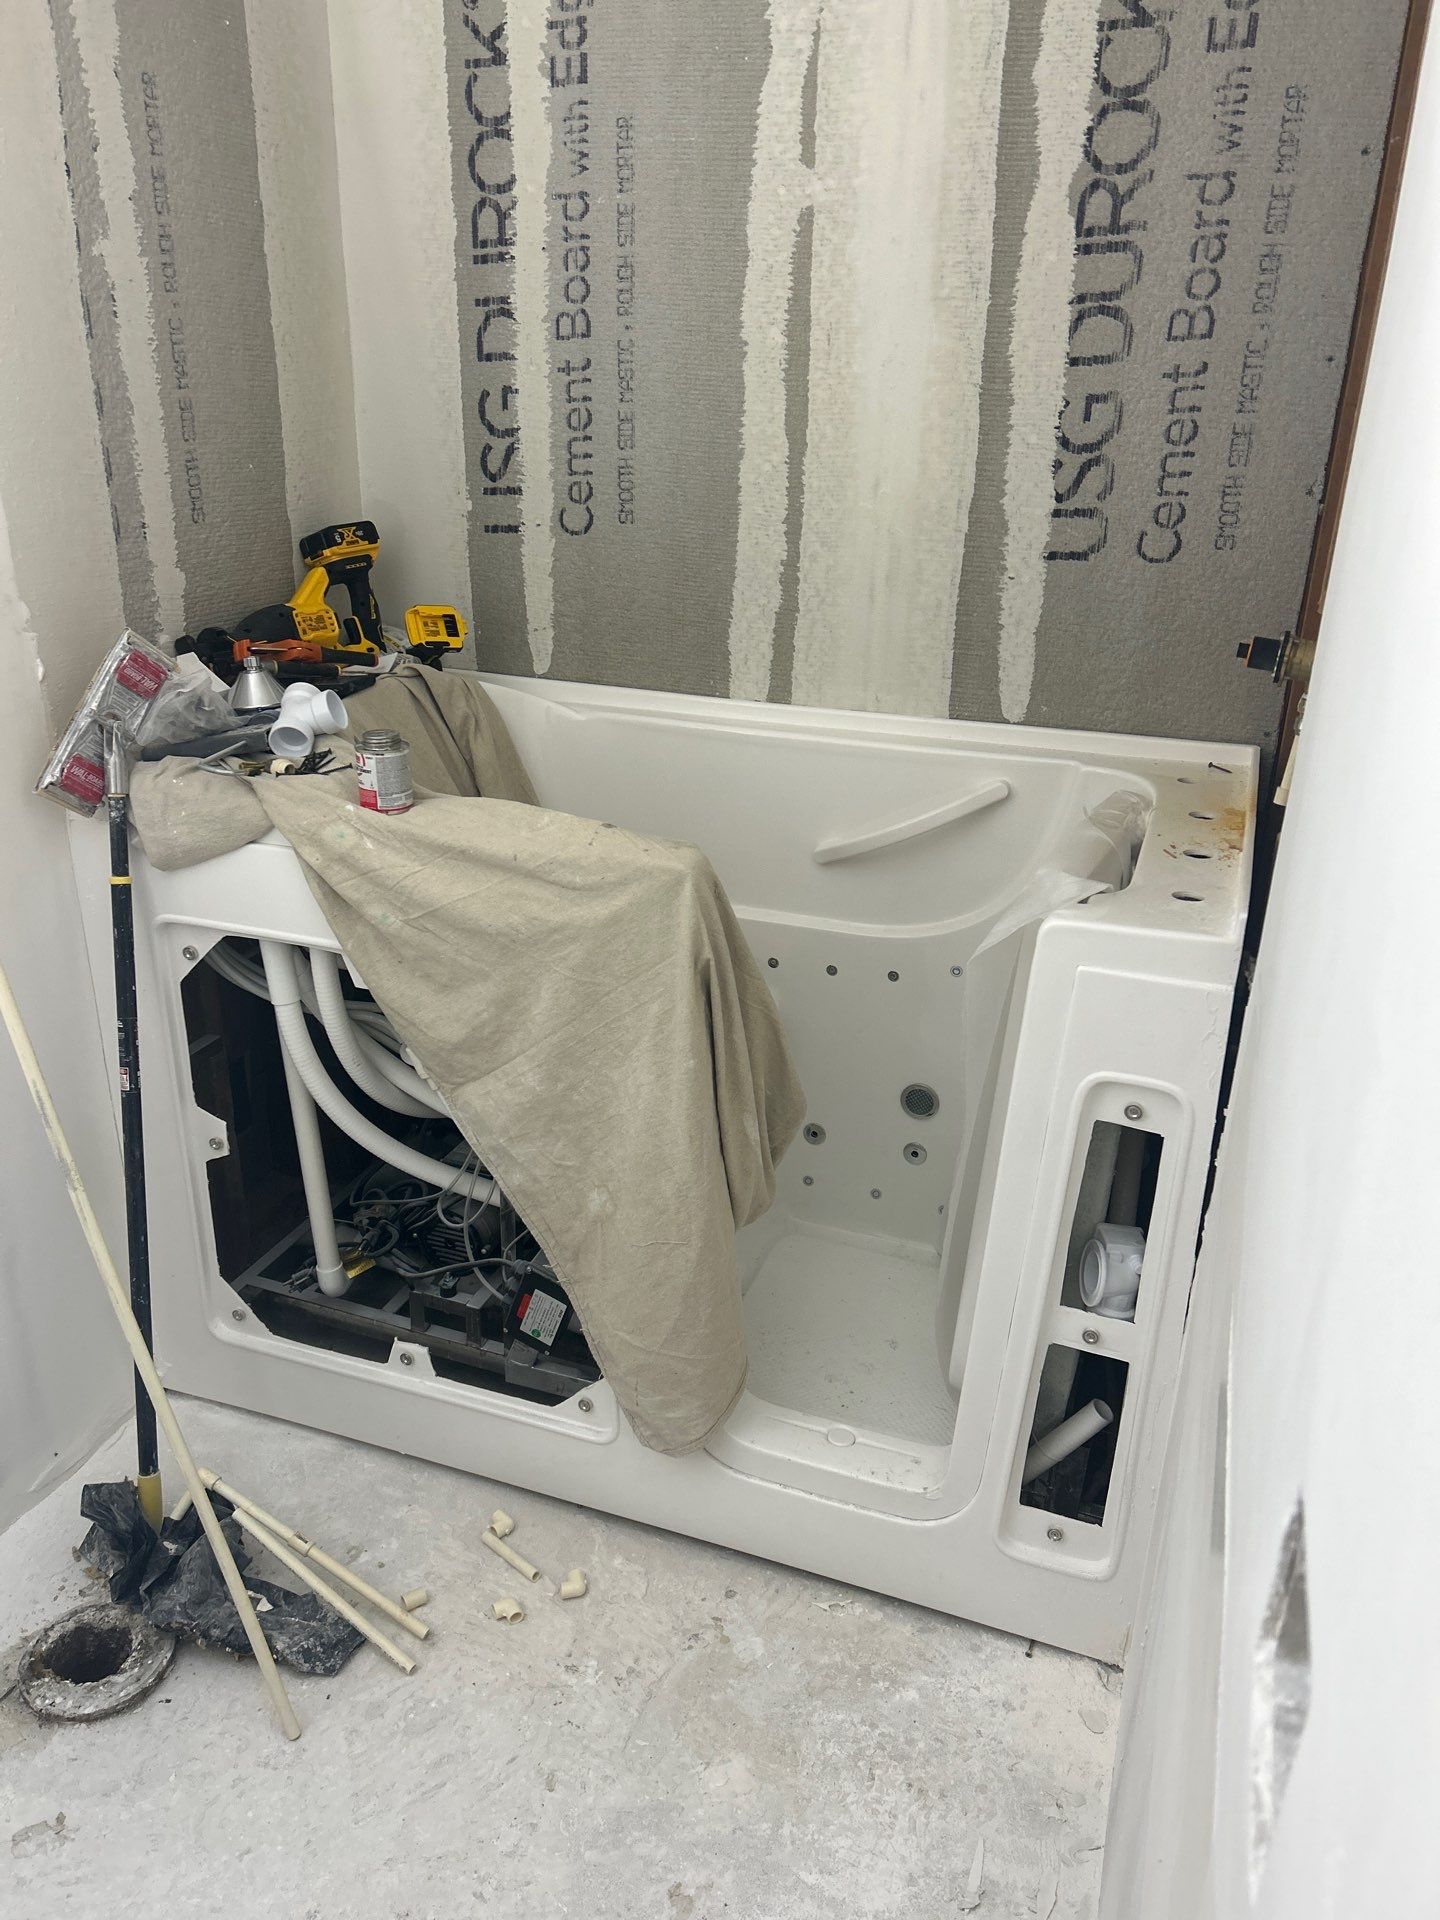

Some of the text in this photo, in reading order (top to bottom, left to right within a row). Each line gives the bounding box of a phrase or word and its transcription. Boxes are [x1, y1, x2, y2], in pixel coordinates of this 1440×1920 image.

[141, 72, 165, 156] MORTAR
[561, 100, 589, 178] with
[1213, 66, 1252, 155] with
[151, 166, 170, 216] SIDE
[157, 224, 178, 293] ROUGH
[1164, 171, 1237, 342] Board
[551, 191, 592, 341] Board
[616, 114, 635, 525] SMOOTH SIDE MASTIC ROUGH SIDE MORTAR
[1213, 84, 1307, 552] SMOOTH SIDE MASTIC ROUGH SIDE MORTAR
[169, 318, 189, 389] MASTIC
[179, 399, 197, 442] SIDE
[477, 385, 524, 534] USG
[556, 357, 594, 536] Cement
[1043, 390, 1123, 562] USG
[1136, 361, 1208, 563] Cement
